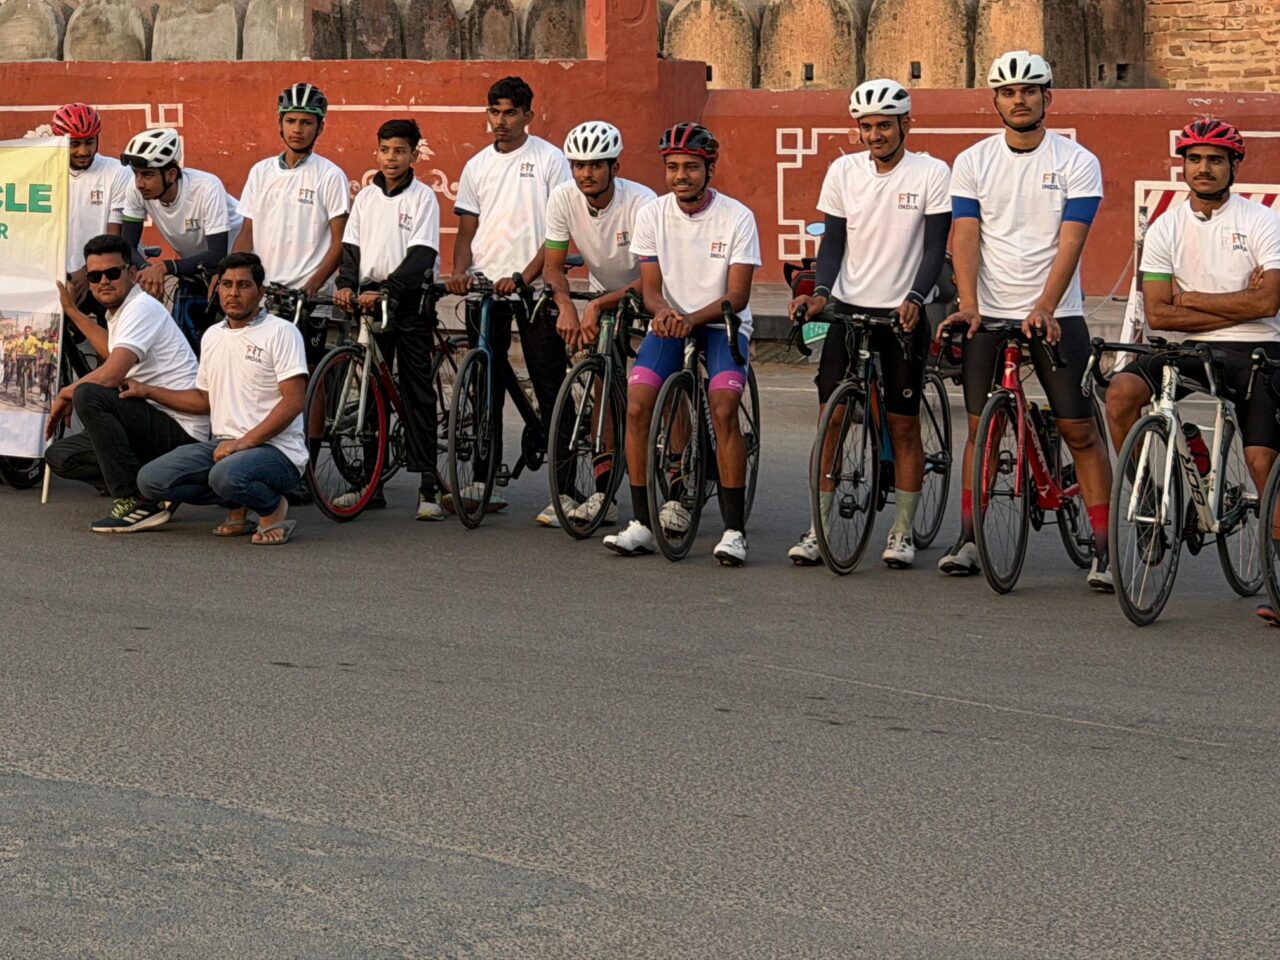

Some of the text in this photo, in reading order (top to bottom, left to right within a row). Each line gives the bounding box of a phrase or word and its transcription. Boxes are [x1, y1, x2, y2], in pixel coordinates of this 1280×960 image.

[520, 162, 535, 172] FIT
[299, 188, 315, 200] FIT
[898, 192, 919, 204] FIT
[711, 242, 727, 253] FIT
[246, 345, 264, 357] FIT
